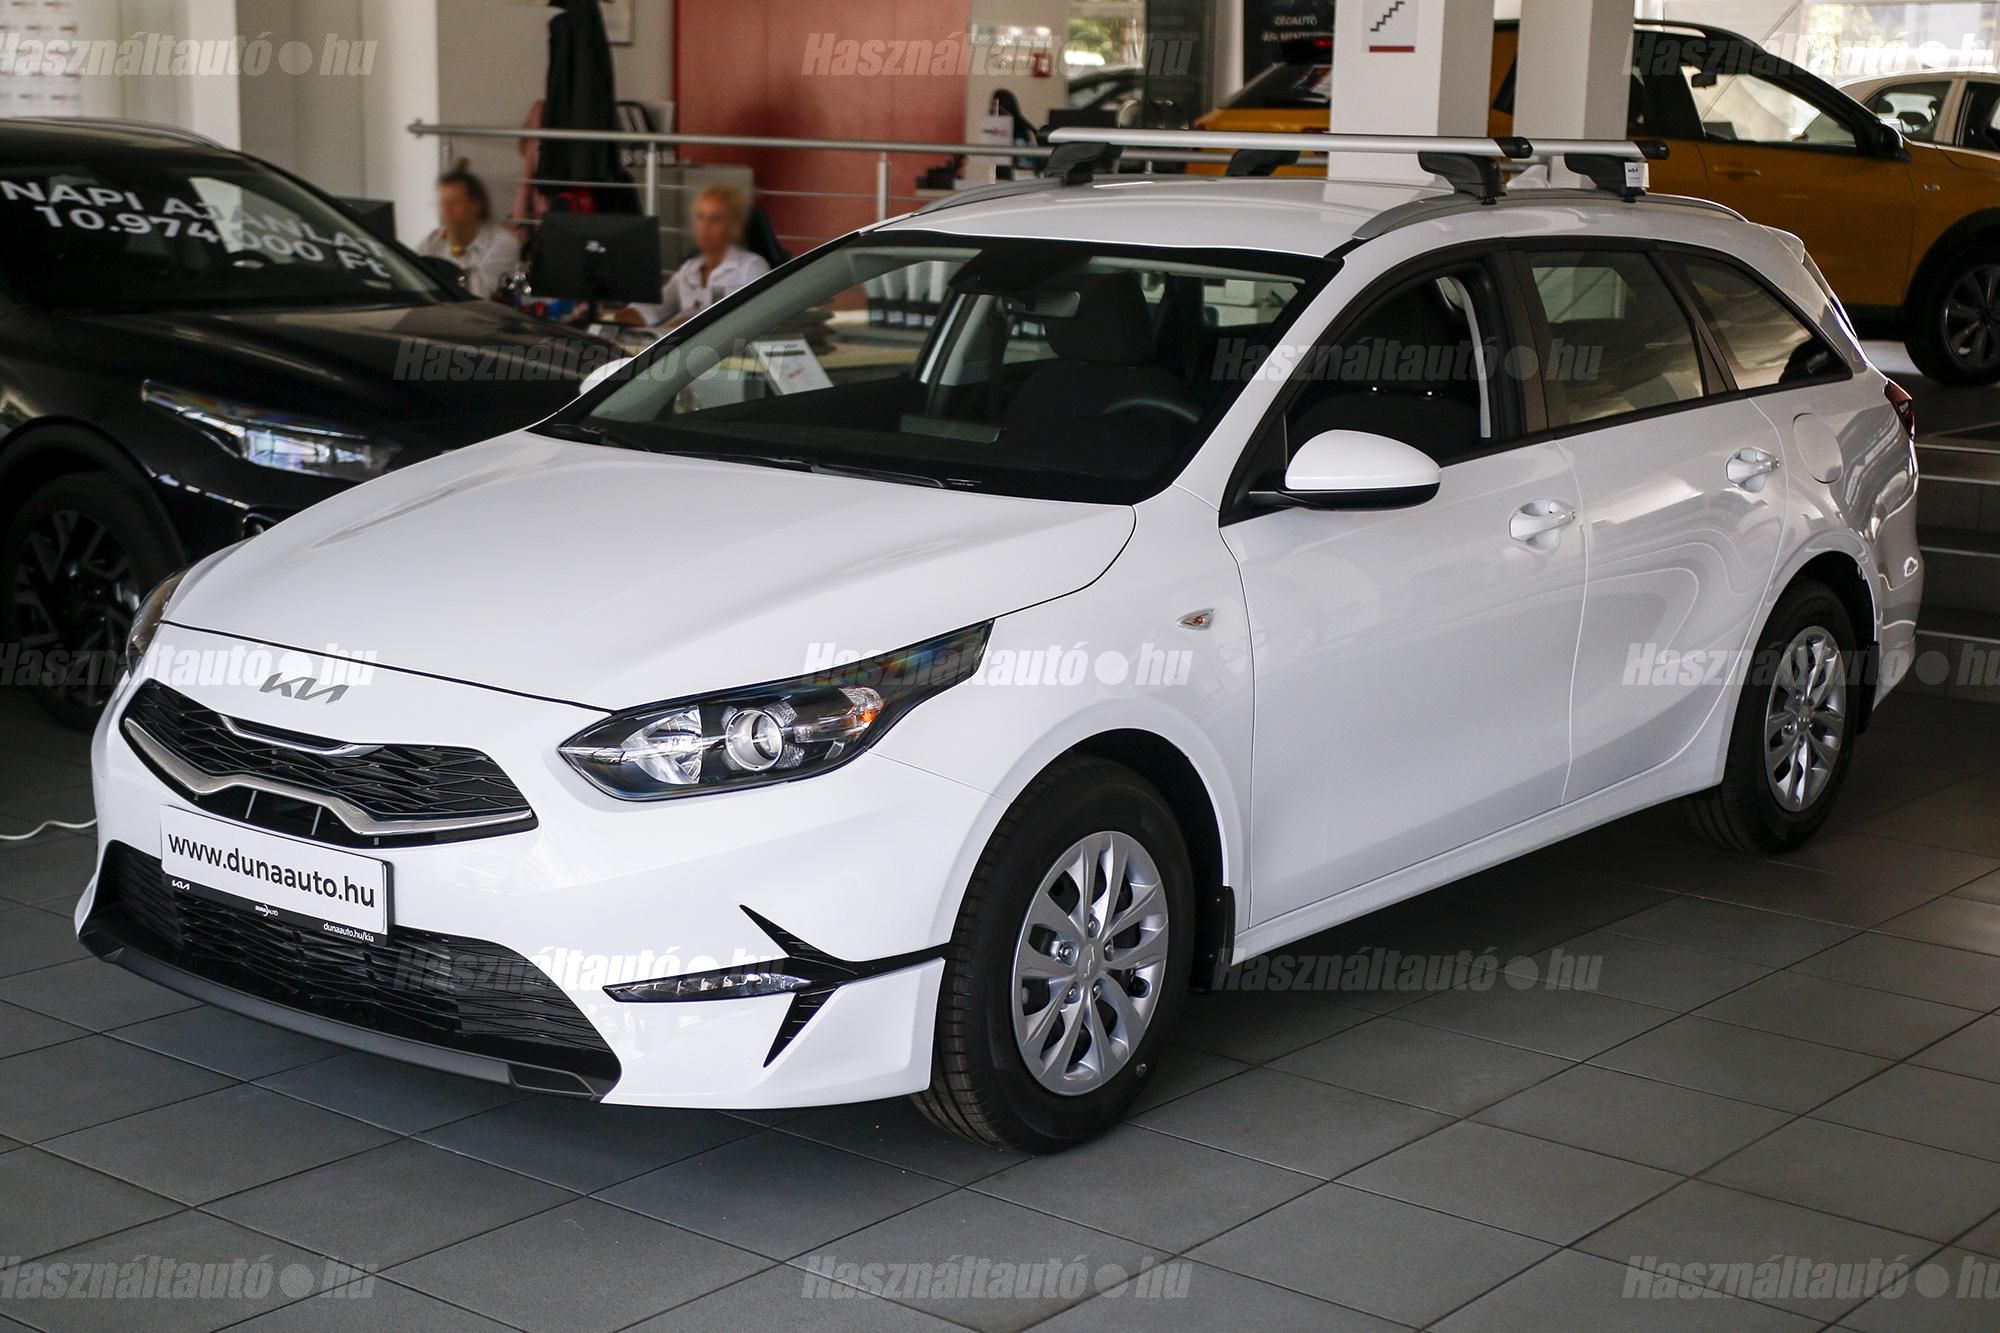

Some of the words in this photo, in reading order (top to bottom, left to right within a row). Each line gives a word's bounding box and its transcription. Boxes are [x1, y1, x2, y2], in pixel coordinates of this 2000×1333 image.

[0, 180, 145, 212] NAPI
[336, 251, 392, 279] Ft
[168, 833, 375, 908] www.dunaauto.hu
[323, 922, 375, 943] dunaauto.hu/kia
